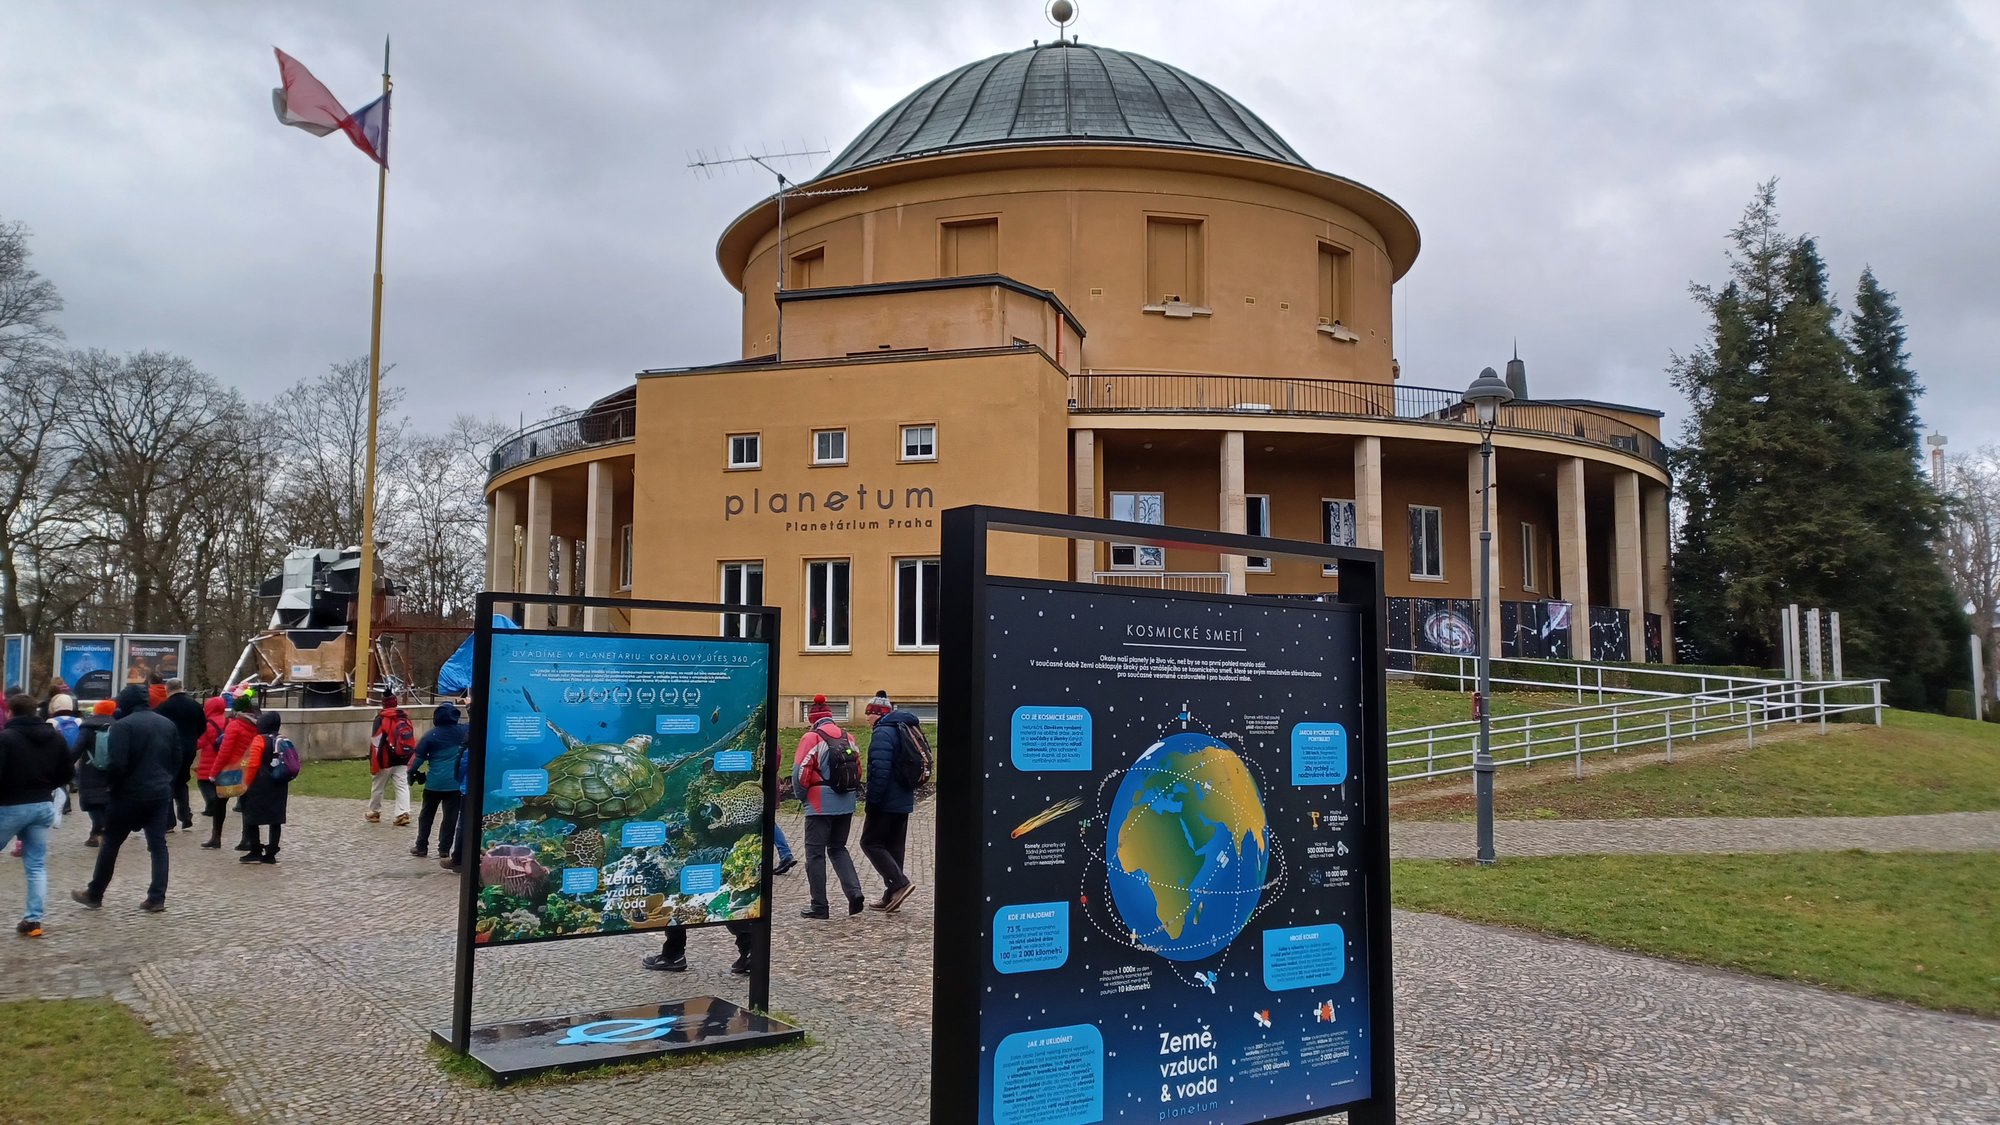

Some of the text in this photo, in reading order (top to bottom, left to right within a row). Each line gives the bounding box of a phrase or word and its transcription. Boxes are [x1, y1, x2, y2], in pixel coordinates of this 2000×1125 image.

[725, 483, 933, 521] planetum
[786, 517, 933, 532] Planetárium Praha
[1126, 625, 1243, 642] KOSMICKÉ SMETÍ
[649, 652, 702, 662] KORÁLOVÝ
[731, 655, 748, 663] 360
[1094, 662, 1122, 670] obklopuje
[604, 871, 647, 886] Země,
[606, 885, 647, 898] vzduch
[603, 898, 646, 911] & voda
[1026, 910, 1056, 920] NAJDEME?
[1035, 946, 1062, 956] kilometrů
[1125, 982, 1150, 992] kilometrů
[1159, 1024, 1217, 1055] Země,
[1159, 1051, 1218, 1078] vzduch
[1160, 1075, 1218, 1103] & voda
[1159, 1100, 1218, 1122] planetum
